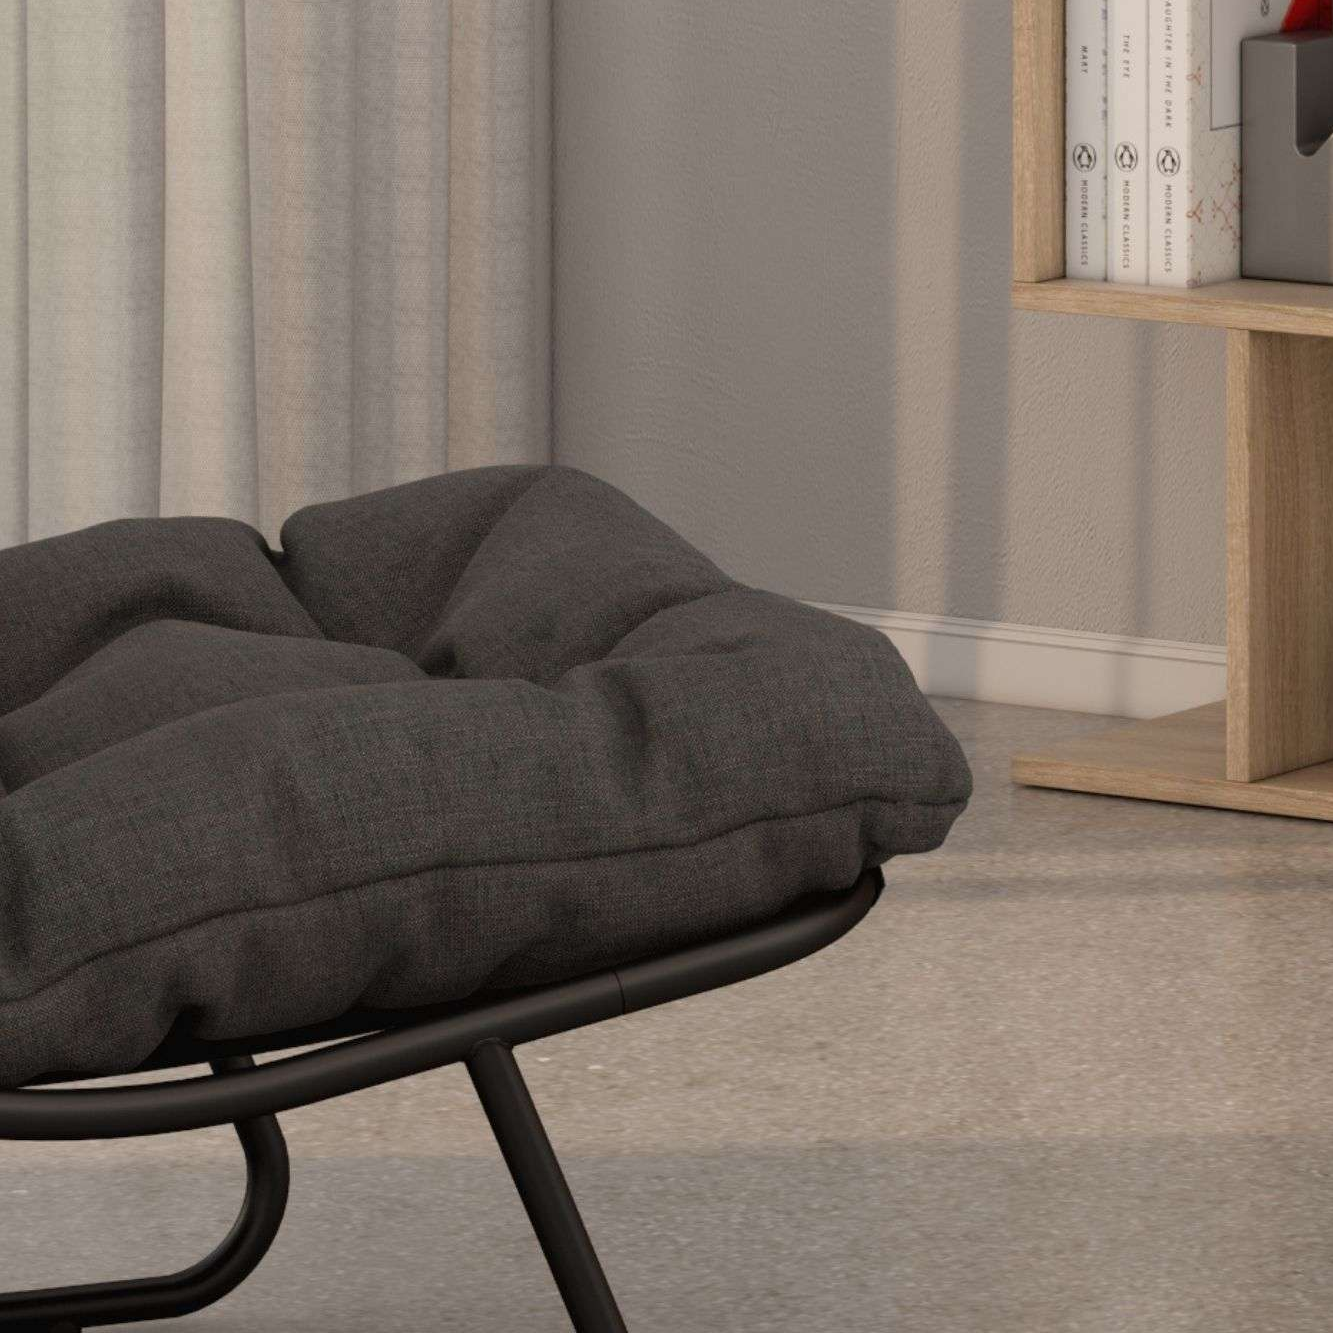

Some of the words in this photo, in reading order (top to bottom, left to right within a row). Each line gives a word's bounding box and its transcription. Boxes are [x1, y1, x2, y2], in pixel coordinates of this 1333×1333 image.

[1080, 45, 1090, 74] MARY
[1121, 35, 1132, 54] THE
[1121, 59, 1132, 79] EYE
[1163, 56, 1174, 70] IN
[1163, 75, 1174, 94] THE
[1163, 99, 1174, 128] DARK
[1080, 179, 1089, 218] MODERN
[1122, 180, 1131, 220] MODERN
[1164, 184, 1173, 224] MODERN
[1080, 222, 1089, 266] CLASSICS
[1122, 224, 1131, 269] CLASSICS
[1164, 229, 1173, 274] CLASSICS
